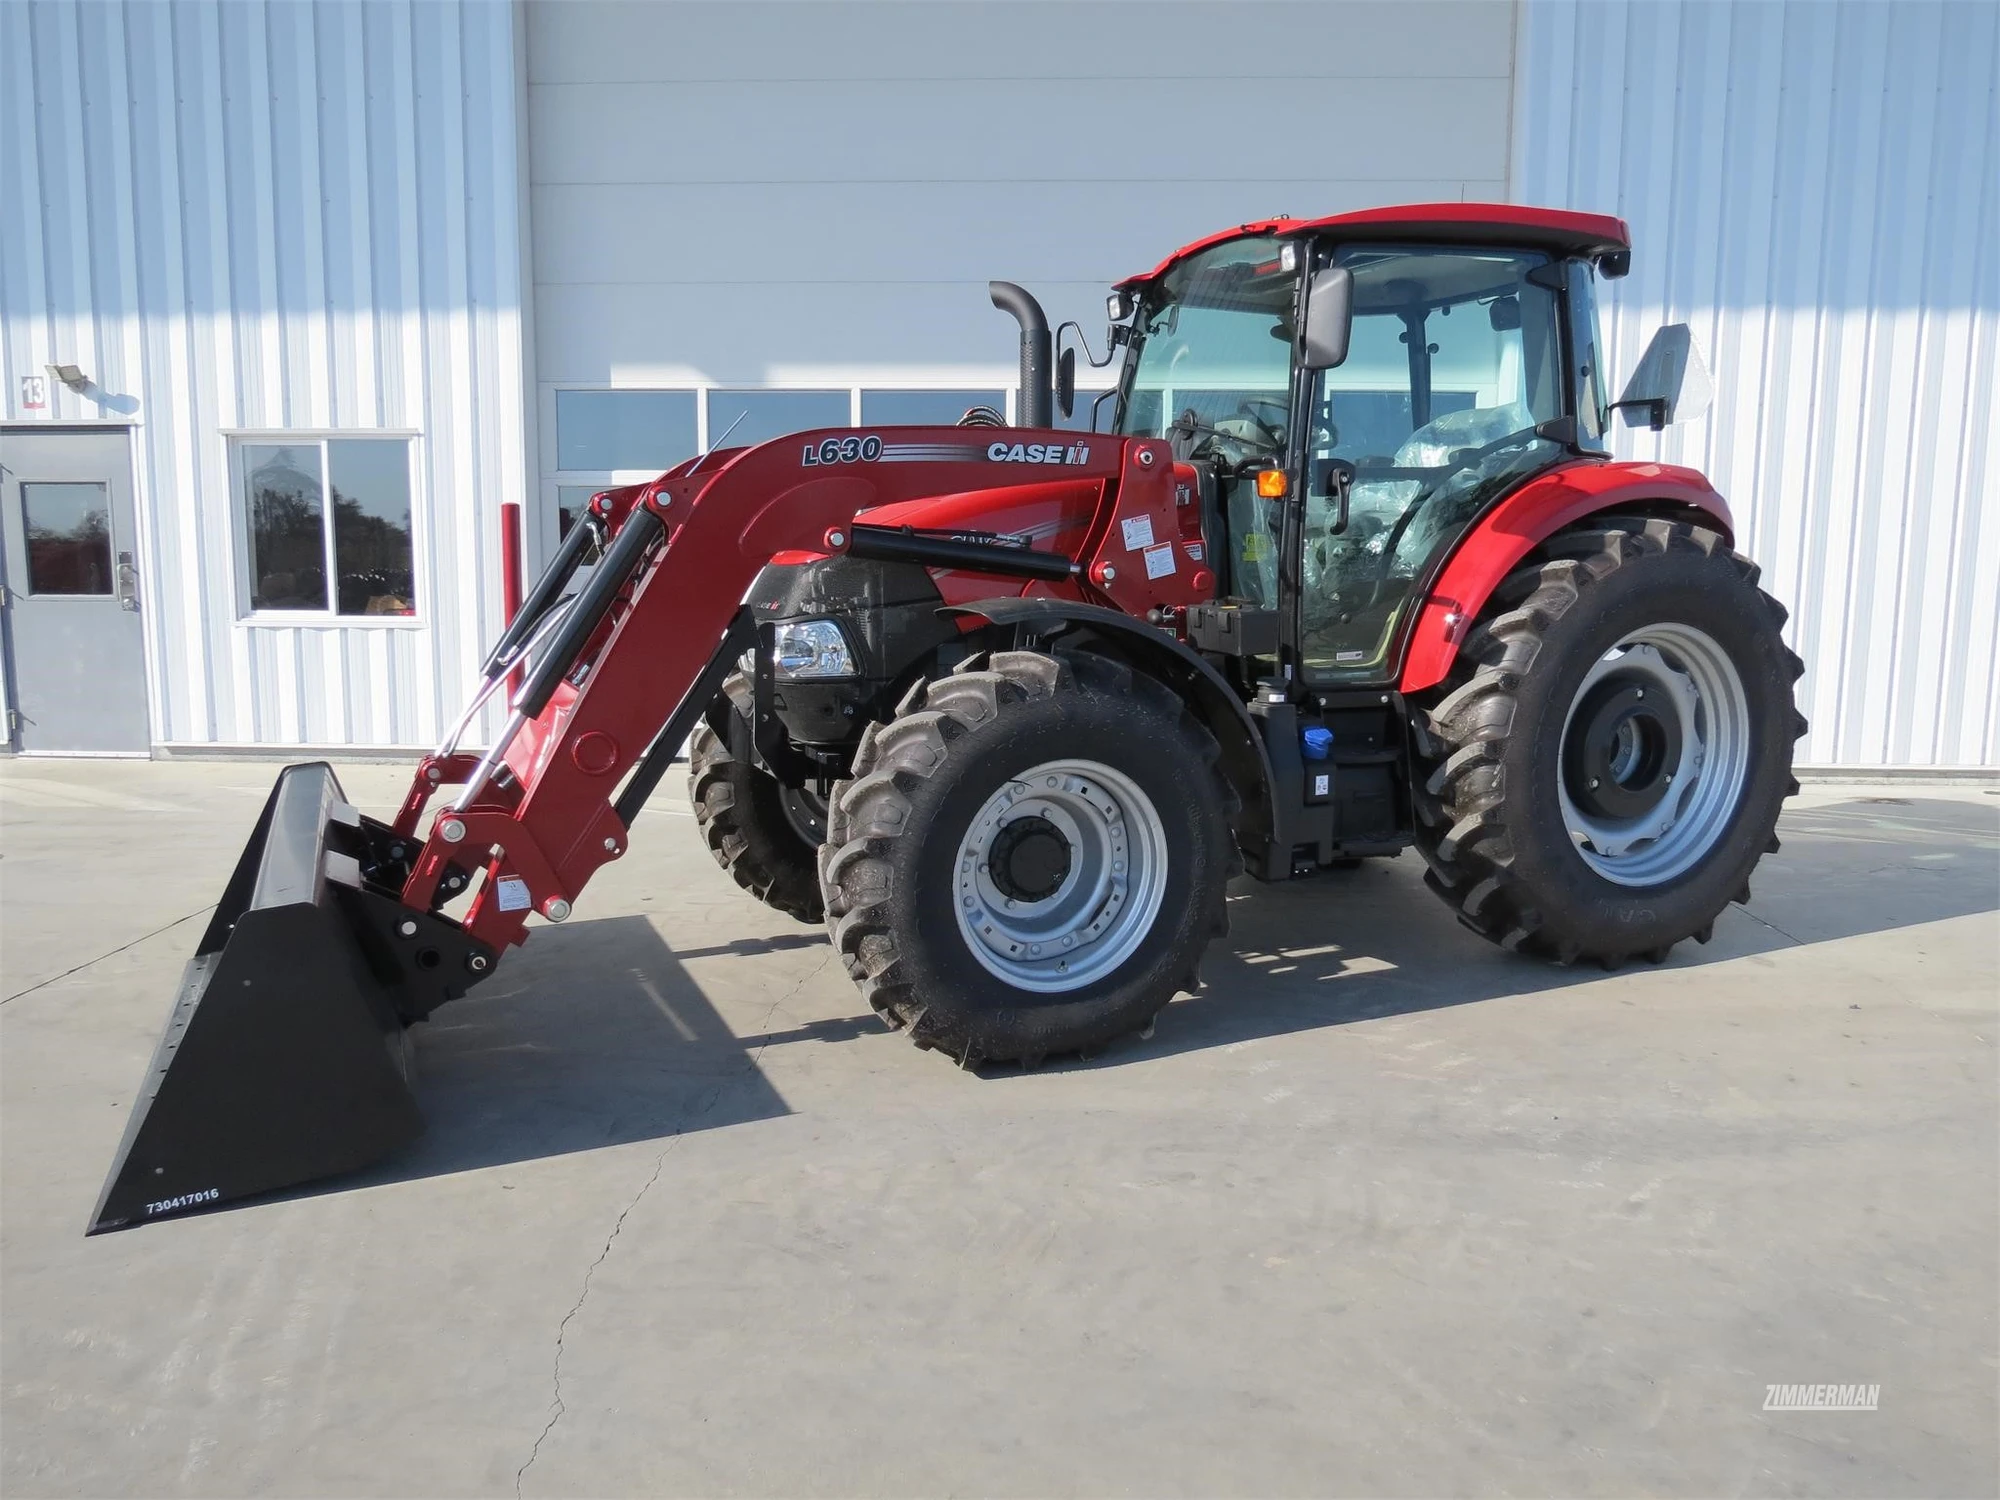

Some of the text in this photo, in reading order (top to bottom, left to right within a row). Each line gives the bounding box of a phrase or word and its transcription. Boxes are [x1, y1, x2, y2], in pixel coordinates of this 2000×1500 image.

[23, 378, 45, 403] 13
[802, 435, 882, 467] L630
[987, 442, 1064, 464] CASE
[146, 1188, 219, 1214] 730417016
